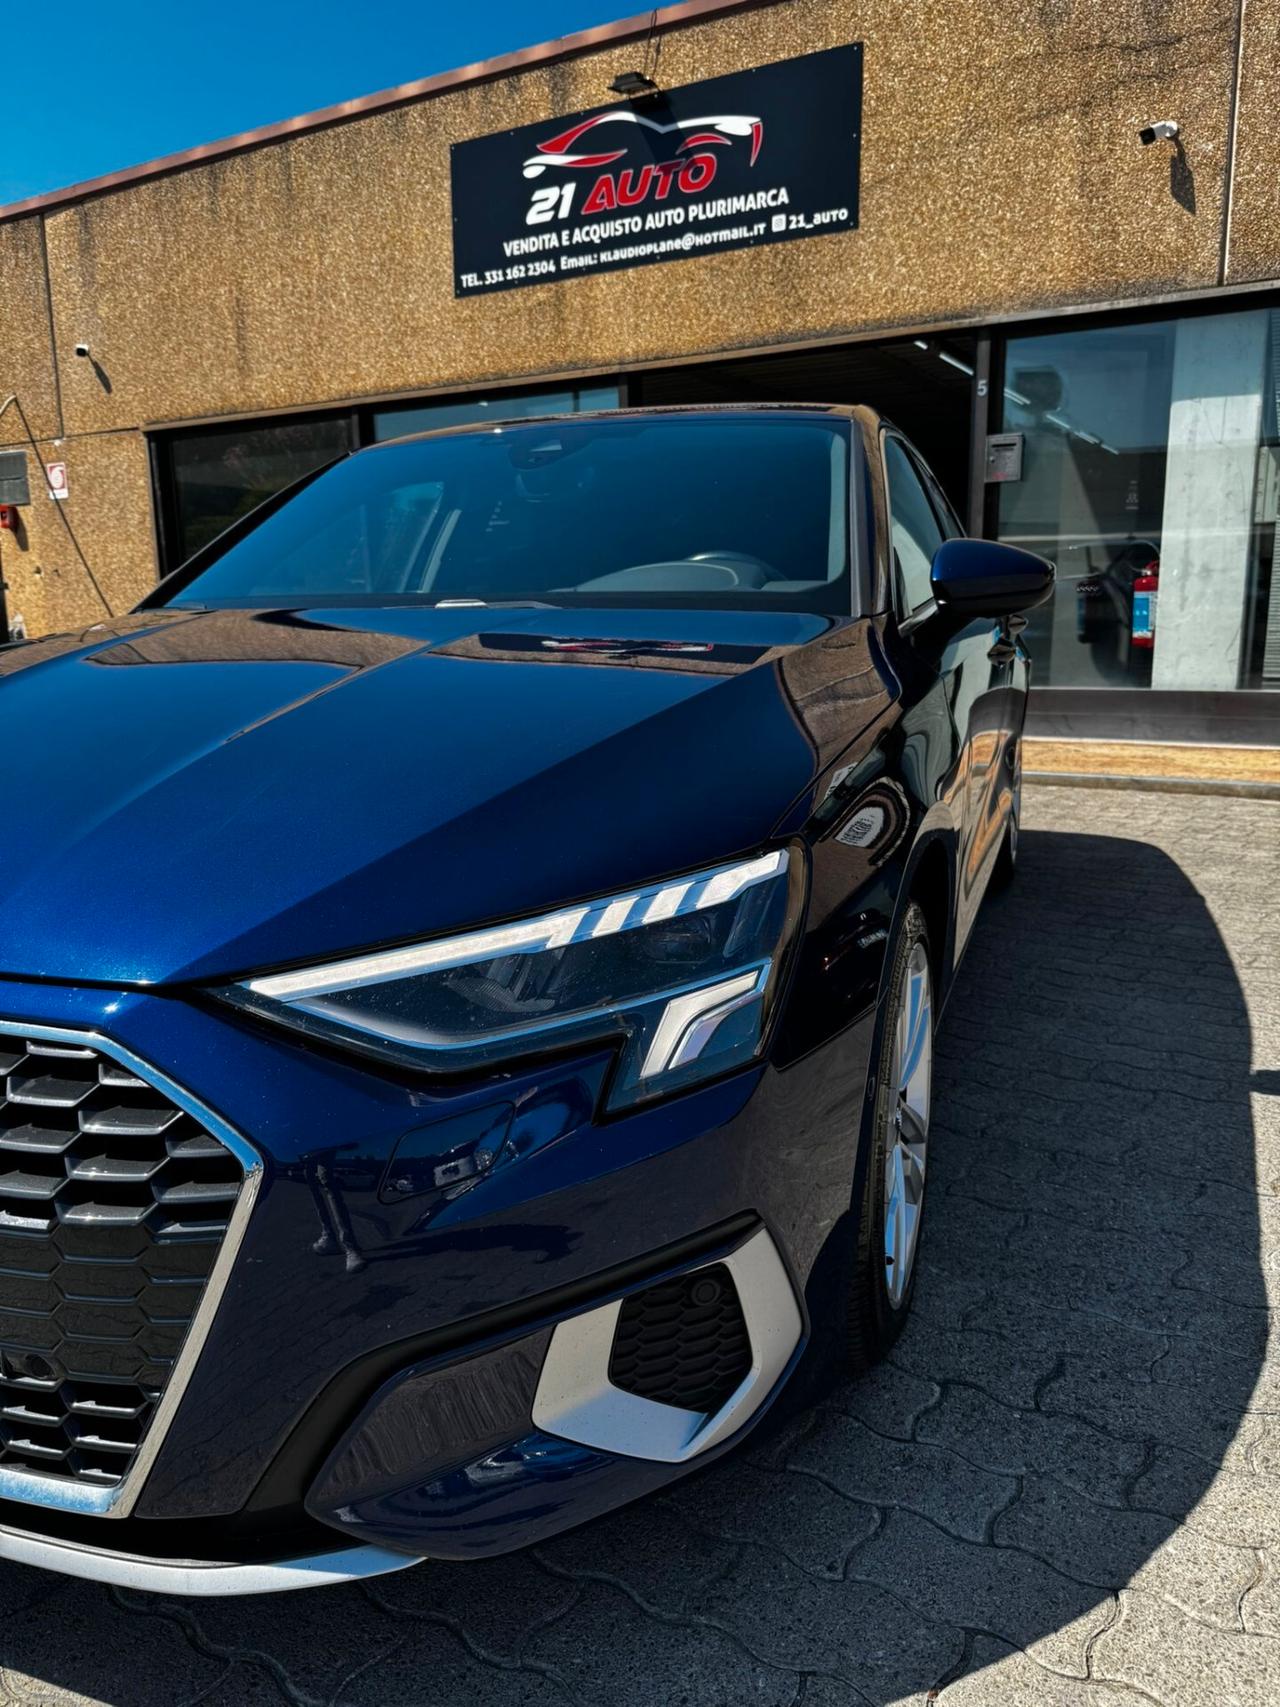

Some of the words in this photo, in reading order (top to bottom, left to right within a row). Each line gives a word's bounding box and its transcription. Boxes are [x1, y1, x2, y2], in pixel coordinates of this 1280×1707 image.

[525, 182, 577, 226] 21
[581, 152, 719, 216] AUTO
[502, 231, 560, 257] VENDITA
[561, 229, 571, 247] E
[572, 215, 643, 245] ACQUISTO
[645, 206, 686, 231] AUTO
[688, 186, 790, 222] PLURIMARCA
[460, 273, 484, 288] TEL.
[484, 269, 505, 285] 331
[506, 264, 526, 281] 162
[527, 259, 556, 277] 2304
[977, 380, 988, 396] 5
